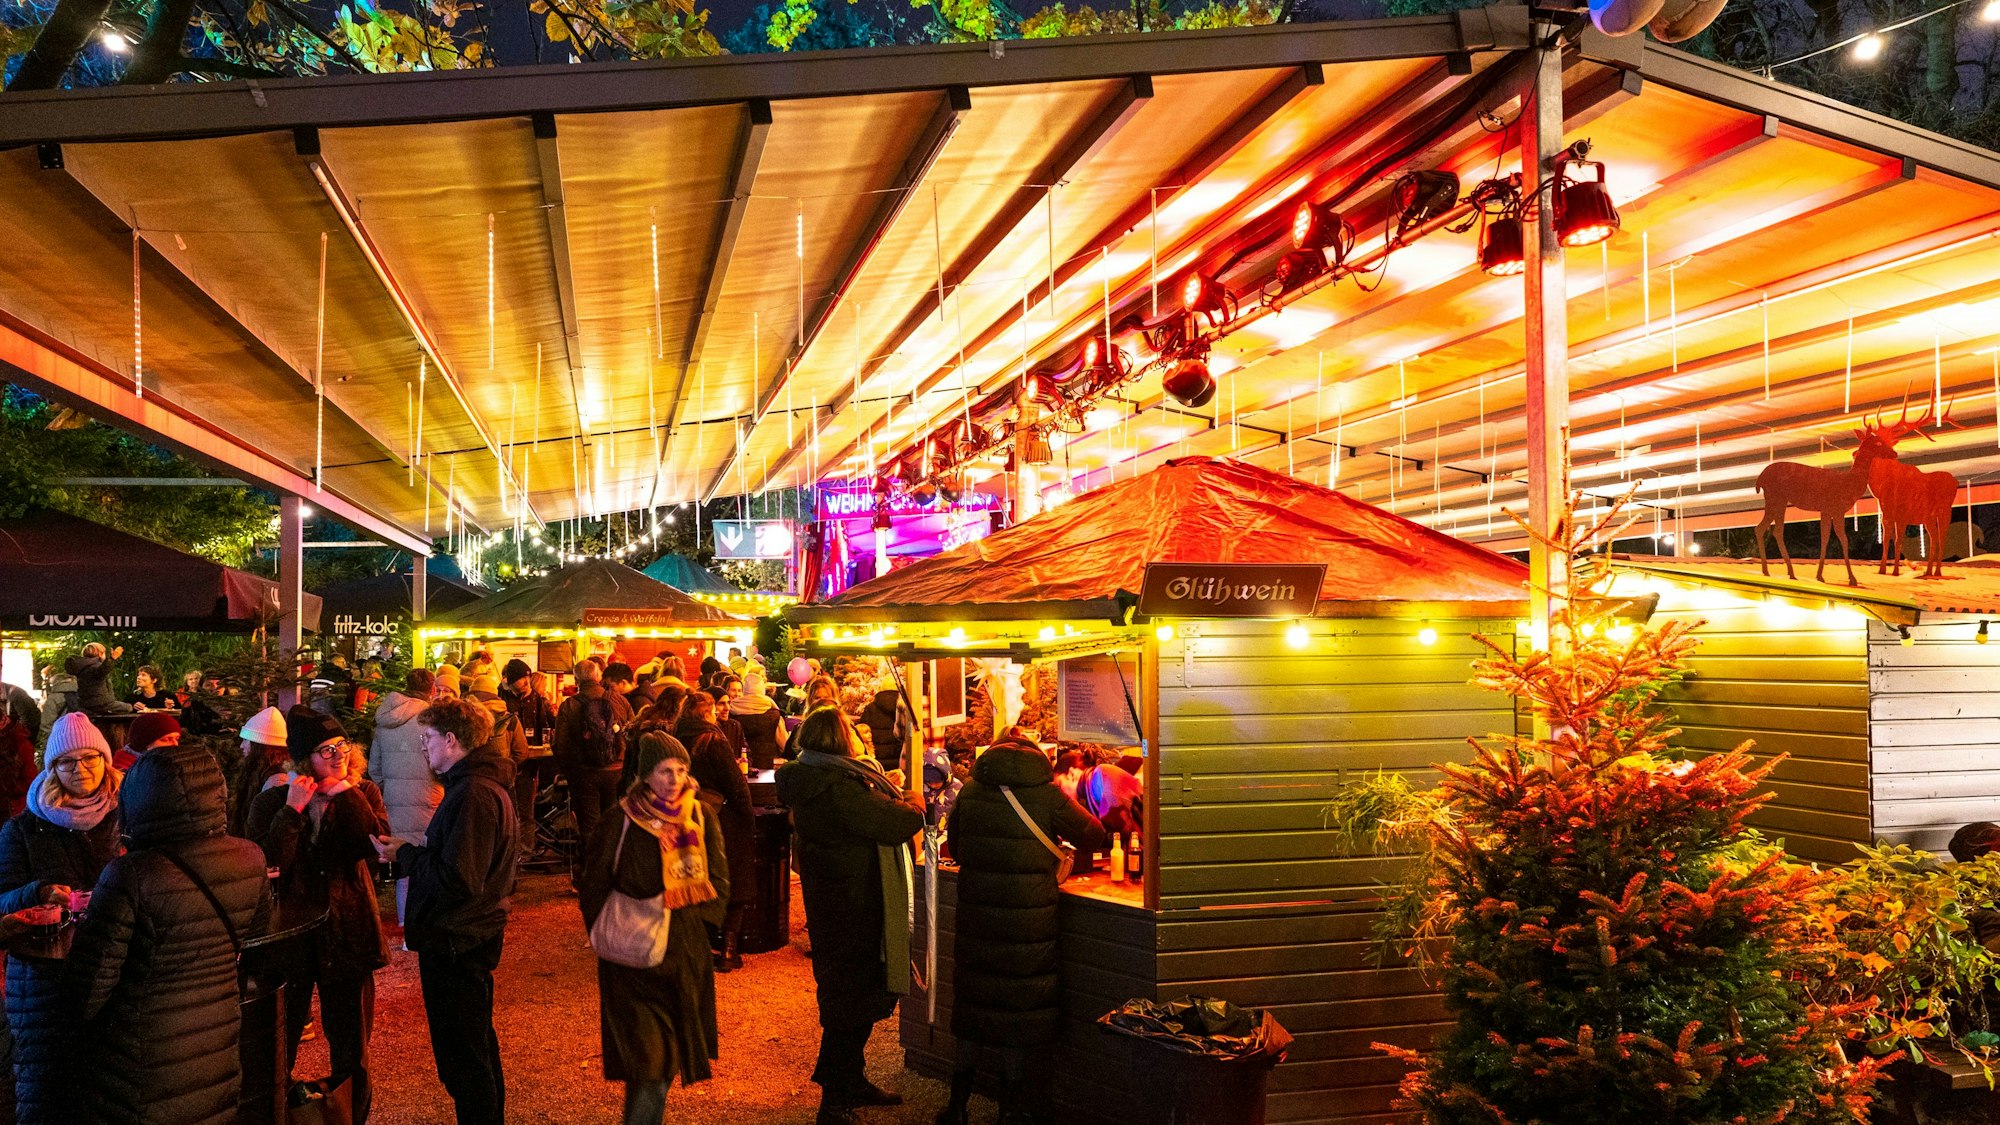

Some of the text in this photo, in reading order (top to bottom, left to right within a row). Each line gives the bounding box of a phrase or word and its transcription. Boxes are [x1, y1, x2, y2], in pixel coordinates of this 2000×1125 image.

[1165, 576, 1295, 606] Glühwein
[334, 614, 398, 634] fritz-kola
[621, 613, 628, 623] &
